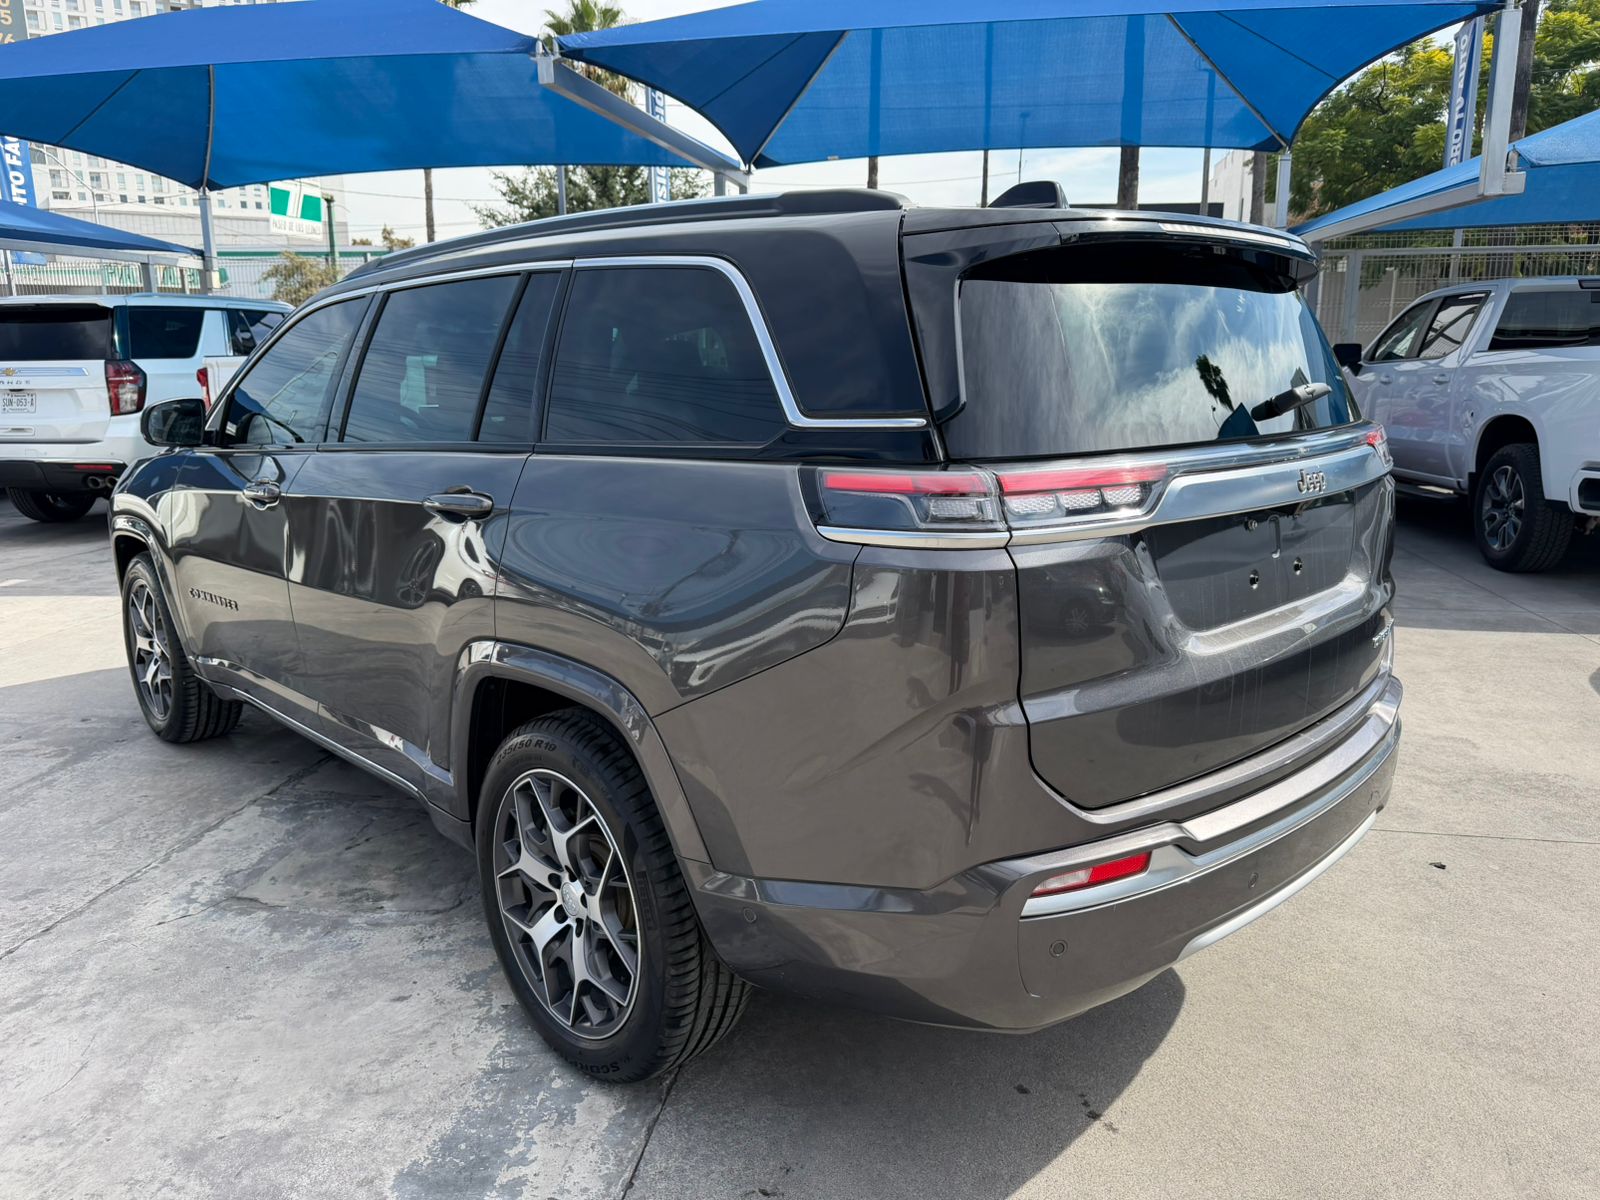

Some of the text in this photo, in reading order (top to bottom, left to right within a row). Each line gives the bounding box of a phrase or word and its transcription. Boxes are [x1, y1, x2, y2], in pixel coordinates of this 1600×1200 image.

[1458, 34, 1468, 89] AUTO
[1455, 96, 1465, 123] TU
[9, 171, 28, 205] ITO
[1297, 468, 1326, 494] Jeep
